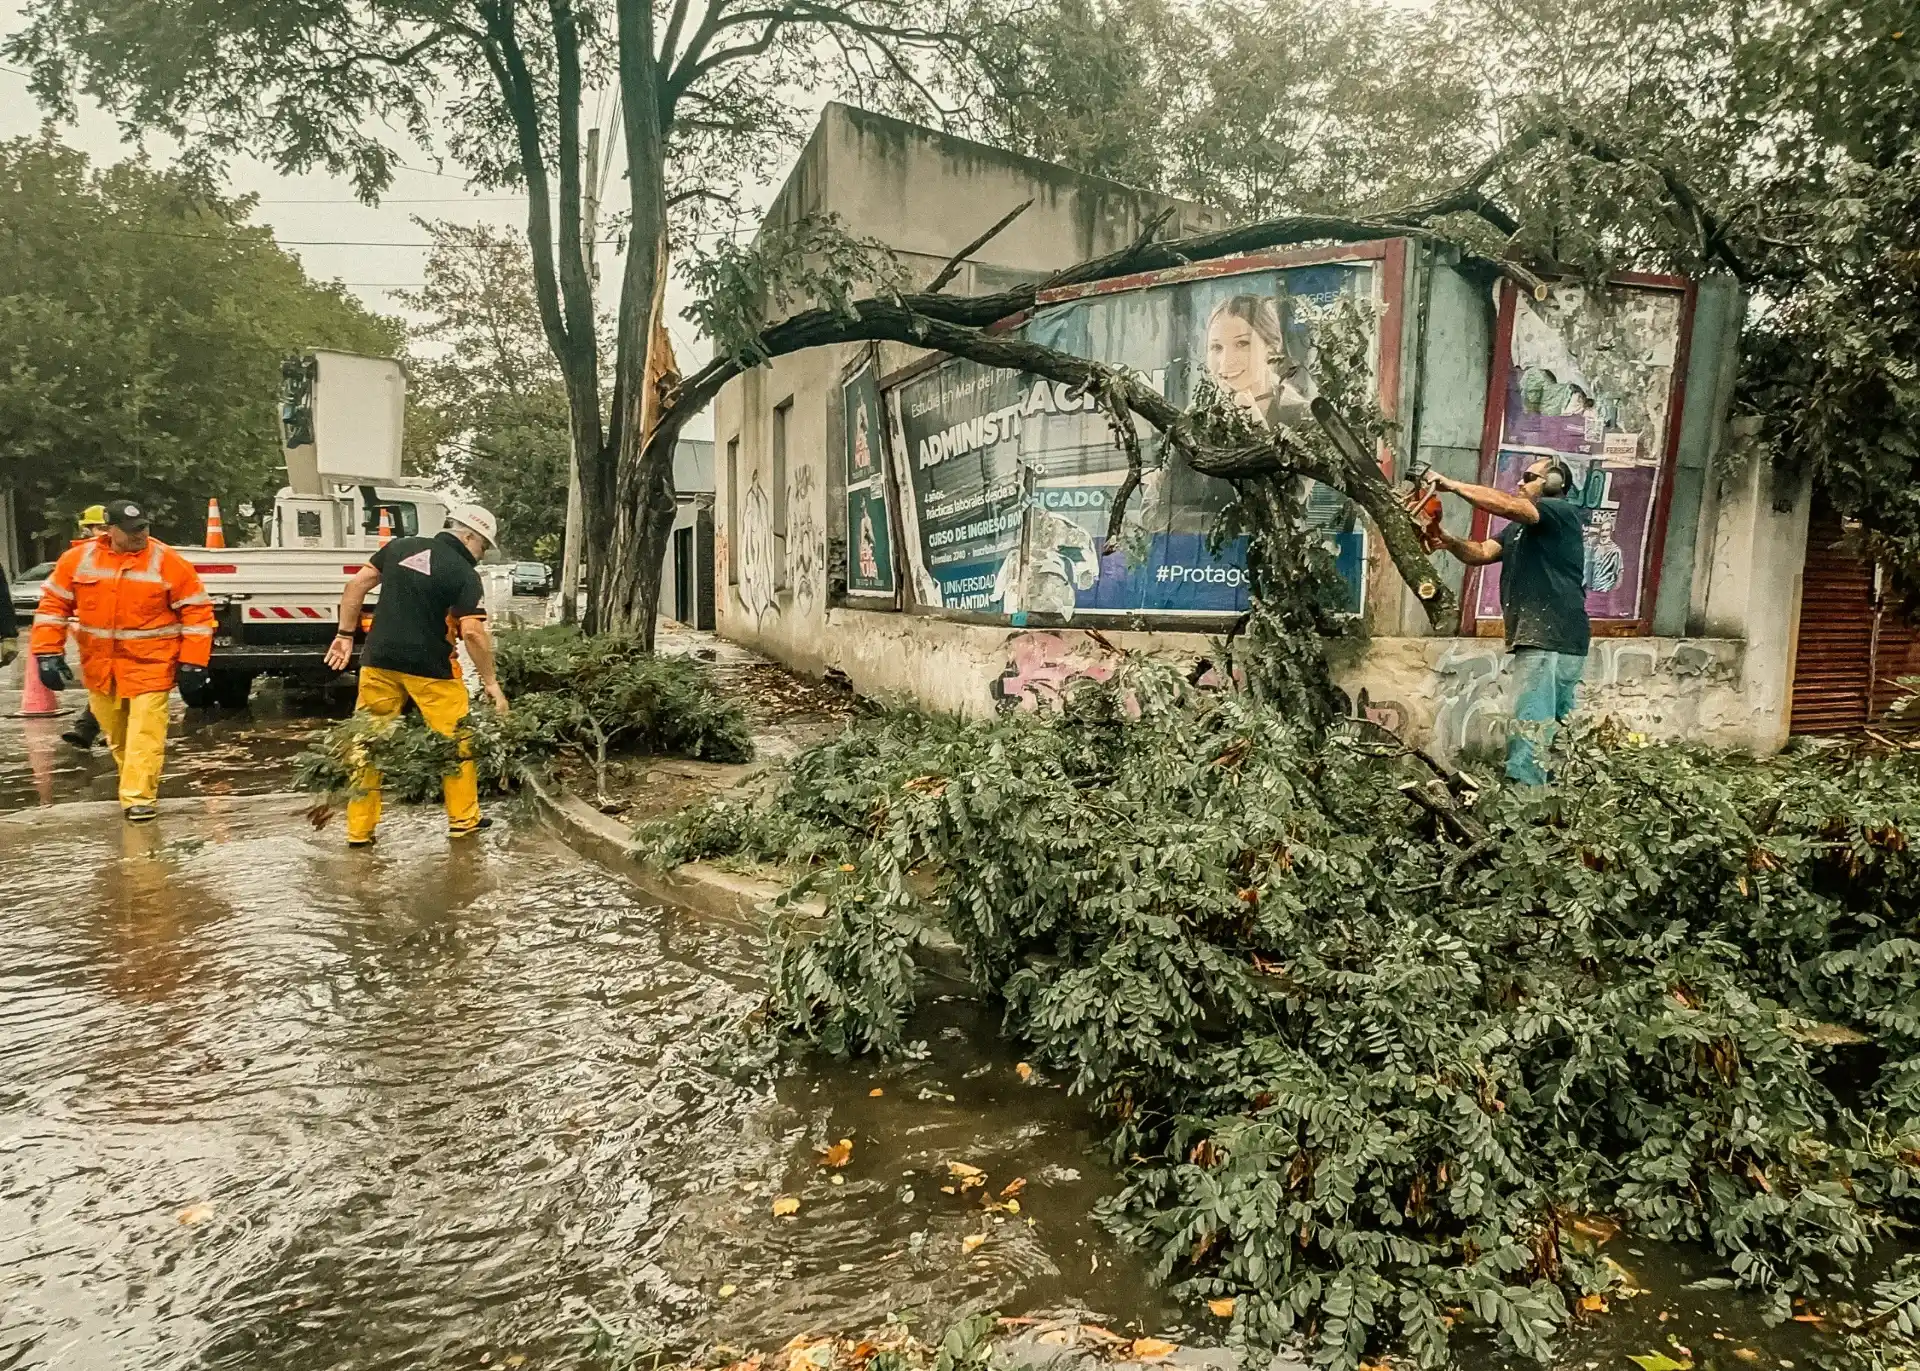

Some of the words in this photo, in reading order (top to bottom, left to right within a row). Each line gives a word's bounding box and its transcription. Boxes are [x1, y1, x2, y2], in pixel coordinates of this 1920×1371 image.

[955, 381, 976, 399] Mar
[977, 369, 994, 391] del
[954, 494, 984, 513] laborales
[929, 529, 954, 547] CURSO
[955, 526, 967, 541] DE
[968, 516, 1007, 538] INGRESO
[943, 573, 996, 595] UNIVERSIDAD
[945, 593, 990, 610] ATLÁNTIDA
